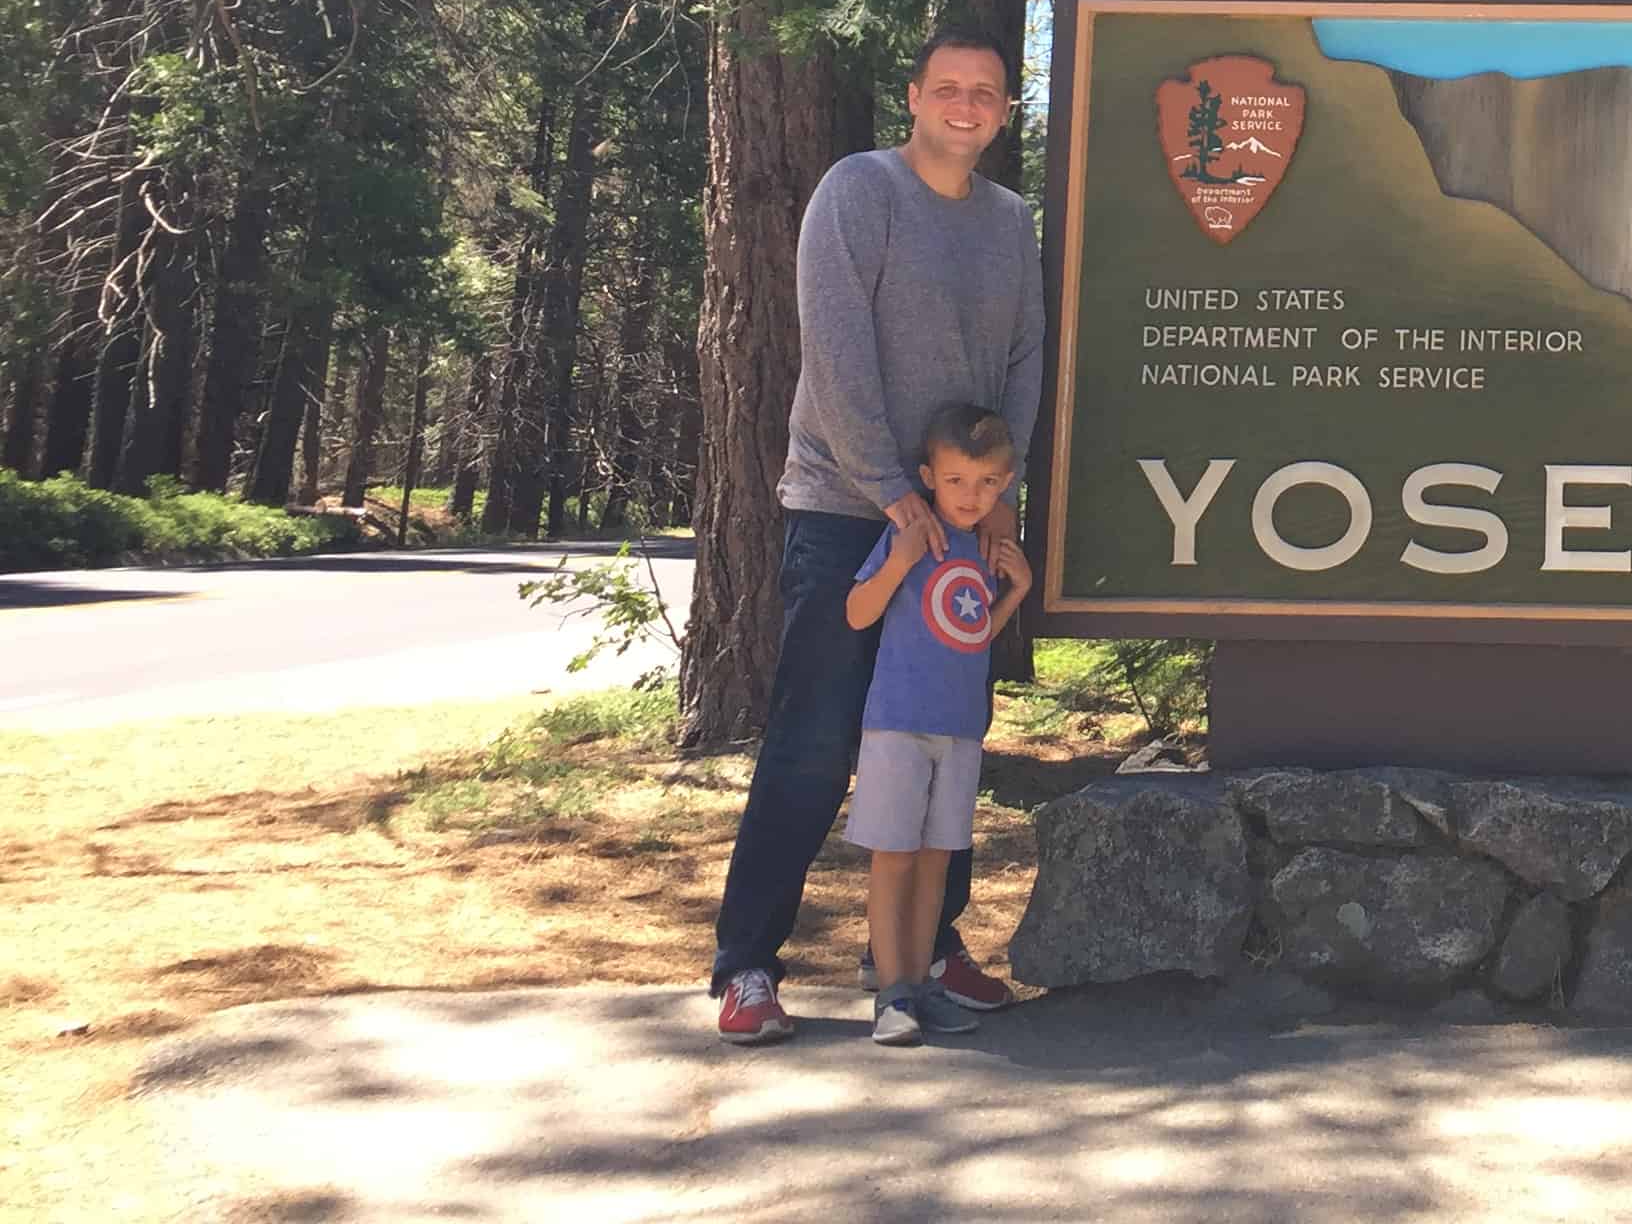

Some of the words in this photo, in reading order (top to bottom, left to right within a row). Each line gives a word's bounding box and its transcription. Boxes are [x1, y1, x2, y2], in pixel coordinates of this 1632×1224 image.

[1231, 95, 1291, 107] NATIONAL
[1241, 108, 1273, 119] PARK
[1231, 119, 1283, 131] SERVICE
[1144, 289, 1240, 311] UNITED
[1255, 289, 1346, 312] STATES
[1142, 326, 1318, 349] DEPARTMENT
[1340, 328, 1379, 351] OF
[1394, 329, 1446, 352] THE
[1459, 329, 1584, 353] INTERIOR
[1140, 363, 1277, 388] NATIONAL
[1291, 365, 1361, 388] PARK
[1377, 367, 1486, 390] SERVICE
